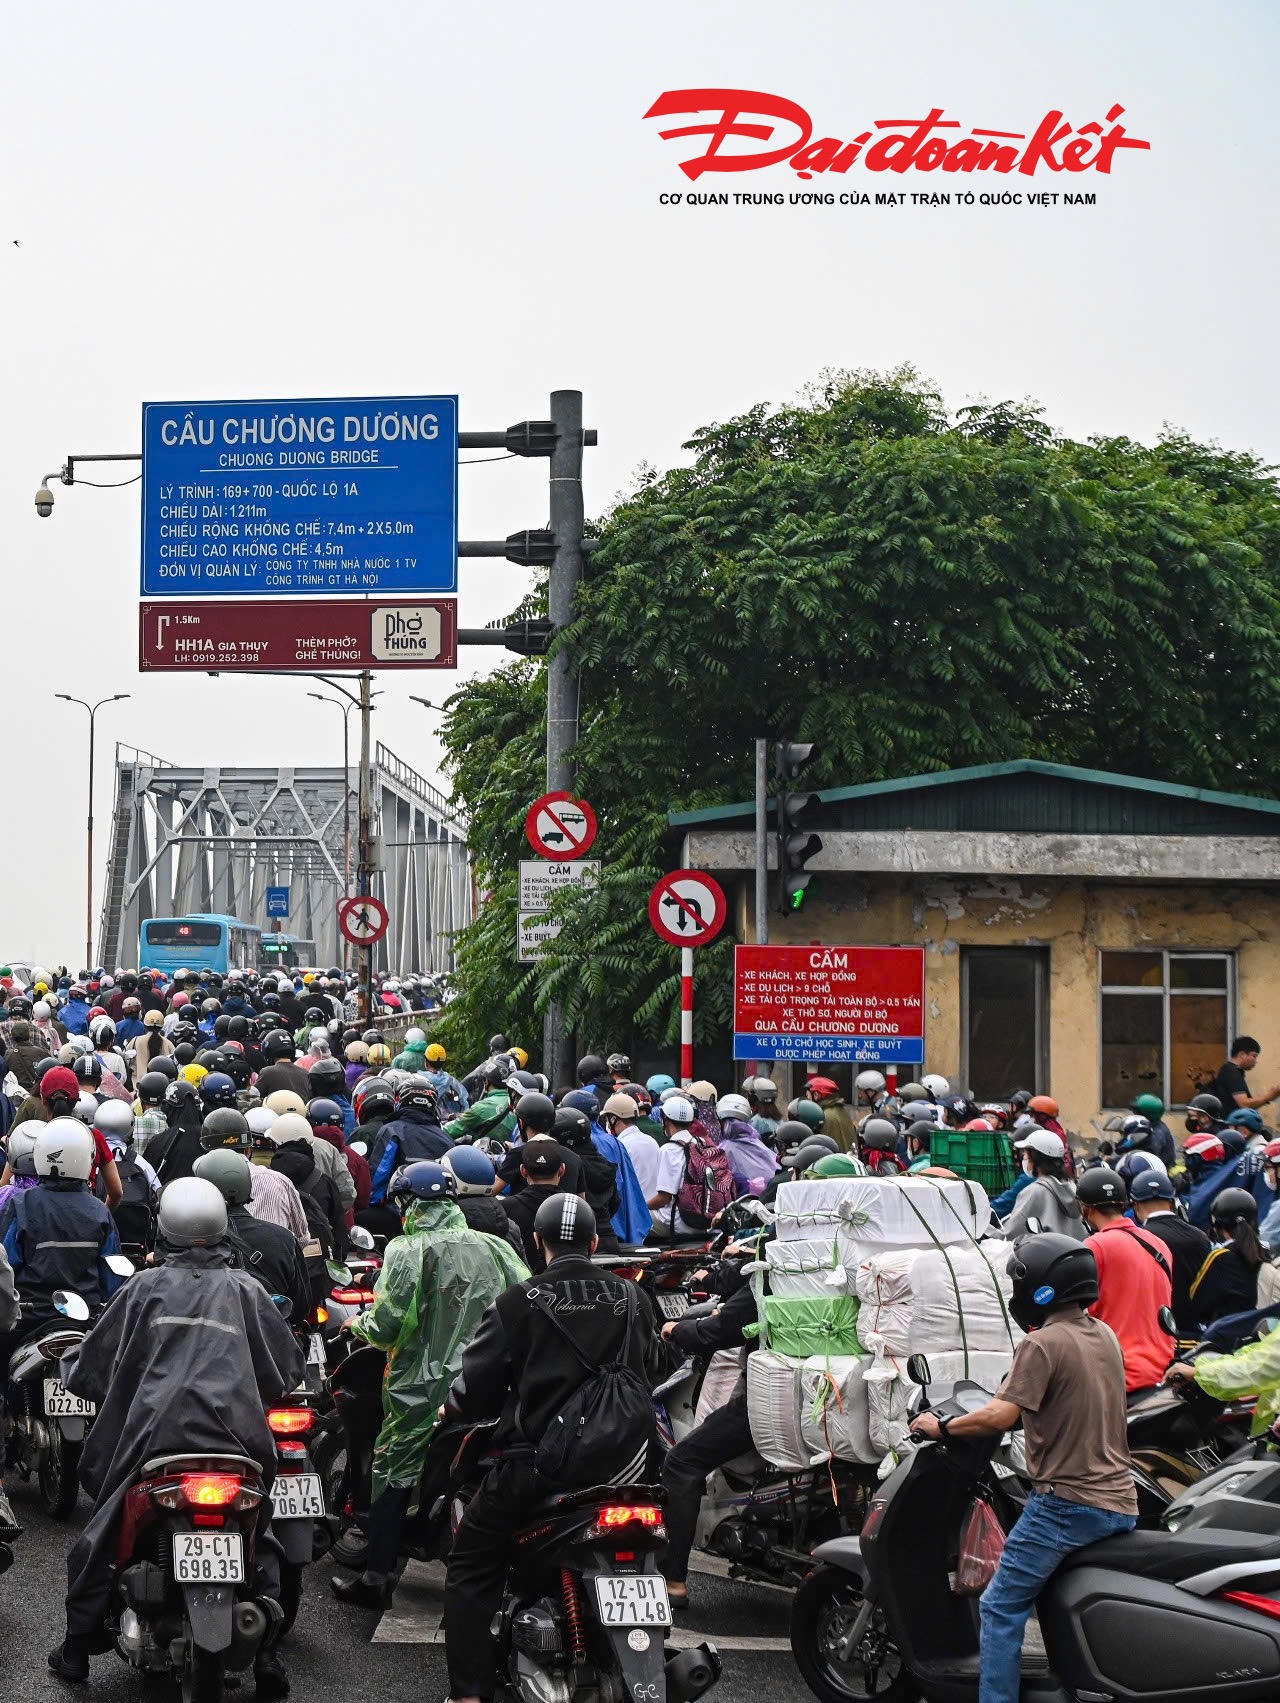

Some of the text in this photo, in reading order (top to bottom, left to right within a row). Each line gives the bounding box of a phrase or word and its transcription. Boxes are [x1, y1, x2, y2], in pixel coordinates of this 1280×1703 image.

[161, 411, 439, 446] CẦU CHƯƠNG DƯƠNG
[219, 449, 379, 467] CHUONG DUONG BRIDGE
[160, 483, 173, 499] LÝ
[252, 484, 273, 498] 700
[282, 478, 318, 498] QUỐC
[343, 482, 359, 496] 1A
[160, 500, 197, 519] CHIỀU
[160, 519, 197, 538] CHIỀU
[202, 520, 239, 540] RỘNG
[244, 518, 290, 537] KHỐNG
[160, 540, 197, 558] CHIỀU
[202, 543, 227, 557] CAO
[232, 538, 278, 556] KHỐNG
[190, 563, 201, 579] VỊ
[266, 559, 292, 571] CÔNG
[297, 560, 309, 570] TY
[313, 560, 337, 570] TNHH
[341, 557, 360, 569] NHÀ
[405, 558, 417, 568] TV
[266, 573, 292, 585] CÔNG
[328, 574, 341, 585] GT
[345, 571, 358, 584] HÀ
[363, 571, 379, 587] NỘI
[175, 639, 269, 653] HH1A GIA THỤY
[174, 653, 259, 663] LH: 0919.252.398
[548, 862, 571, 875] CẤM
[810, 948, 848, 969] CẤM
[795, 970, 857, 982] XE HỢP ĐỒNG
[759, 983, 771, 992] DU
[773, 984, 794, 995] LỊCH
[760, 993, 920, 1007] TẢI CÓ TRỌNG TẢI TOÀN BỘ TẤN
[782, 1008, 794, 1017] XE
[798, 1007, 815, 1017] THÔ
[864, 1010, 873, 1018] ĐI
[875, 1008, 888, 1020] BỘ
[755, 1017, 899, 1033] QUA CẦU CHƯƠNG DƯƠNG
[756, 1038, 768, 1046] XE
[781, 1036, 792, 1046] TÔ
[816, 1039, 834, 1050] HỌC
[863, 1040, 875, 1049] XE
[803, 1048, 826, 1059] PHÉP
[828, 1050, 851, 1060] HOẠT
[49, 1399, 91, 1413] 022.90
[273, 1477, 311, 1496] 29-Y7
[272, 1497, 319, 1516] 706.45
[184, 1536, 231, 1557] 29-C1
[179, 1559, 239, 1579] 698.35
[607, 1579, 657, 1599] 12-D1
[605, 1602, 667, 1622] 271.48
